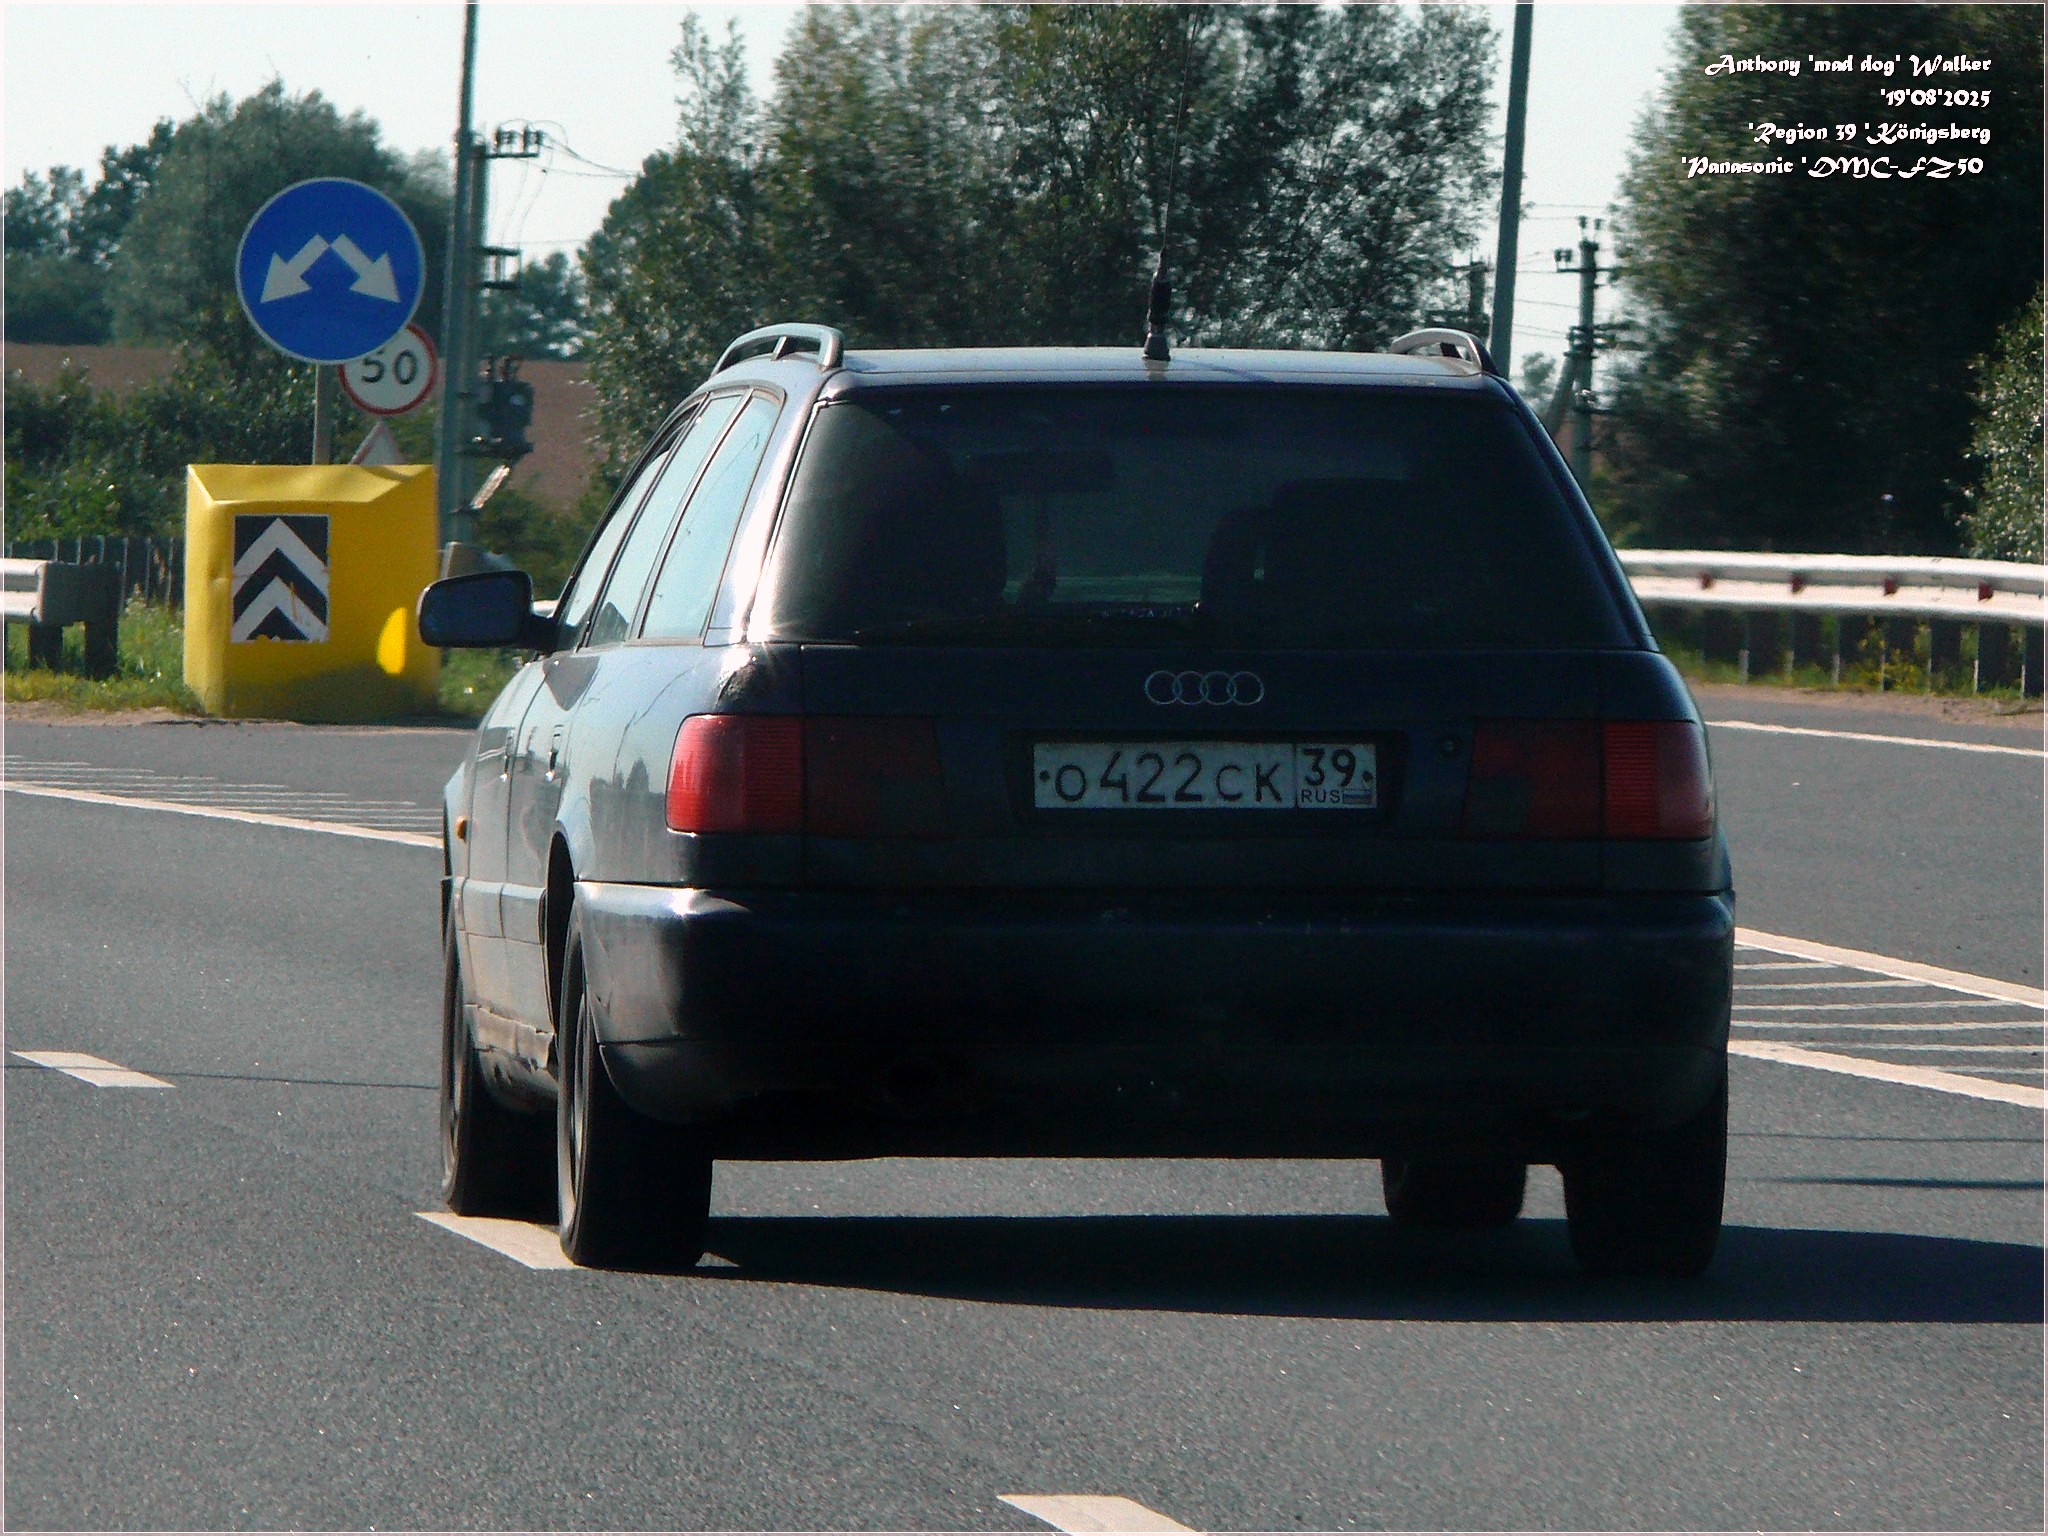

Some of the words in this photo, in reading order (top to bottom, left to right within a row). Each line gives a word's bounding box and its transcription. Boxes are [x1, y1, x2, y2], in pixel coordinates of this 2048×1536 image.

[360, 349, 418, 386] 50
[1302, 747, 1357, 788] 39
[1300, 788, 1341, 804] RUS
